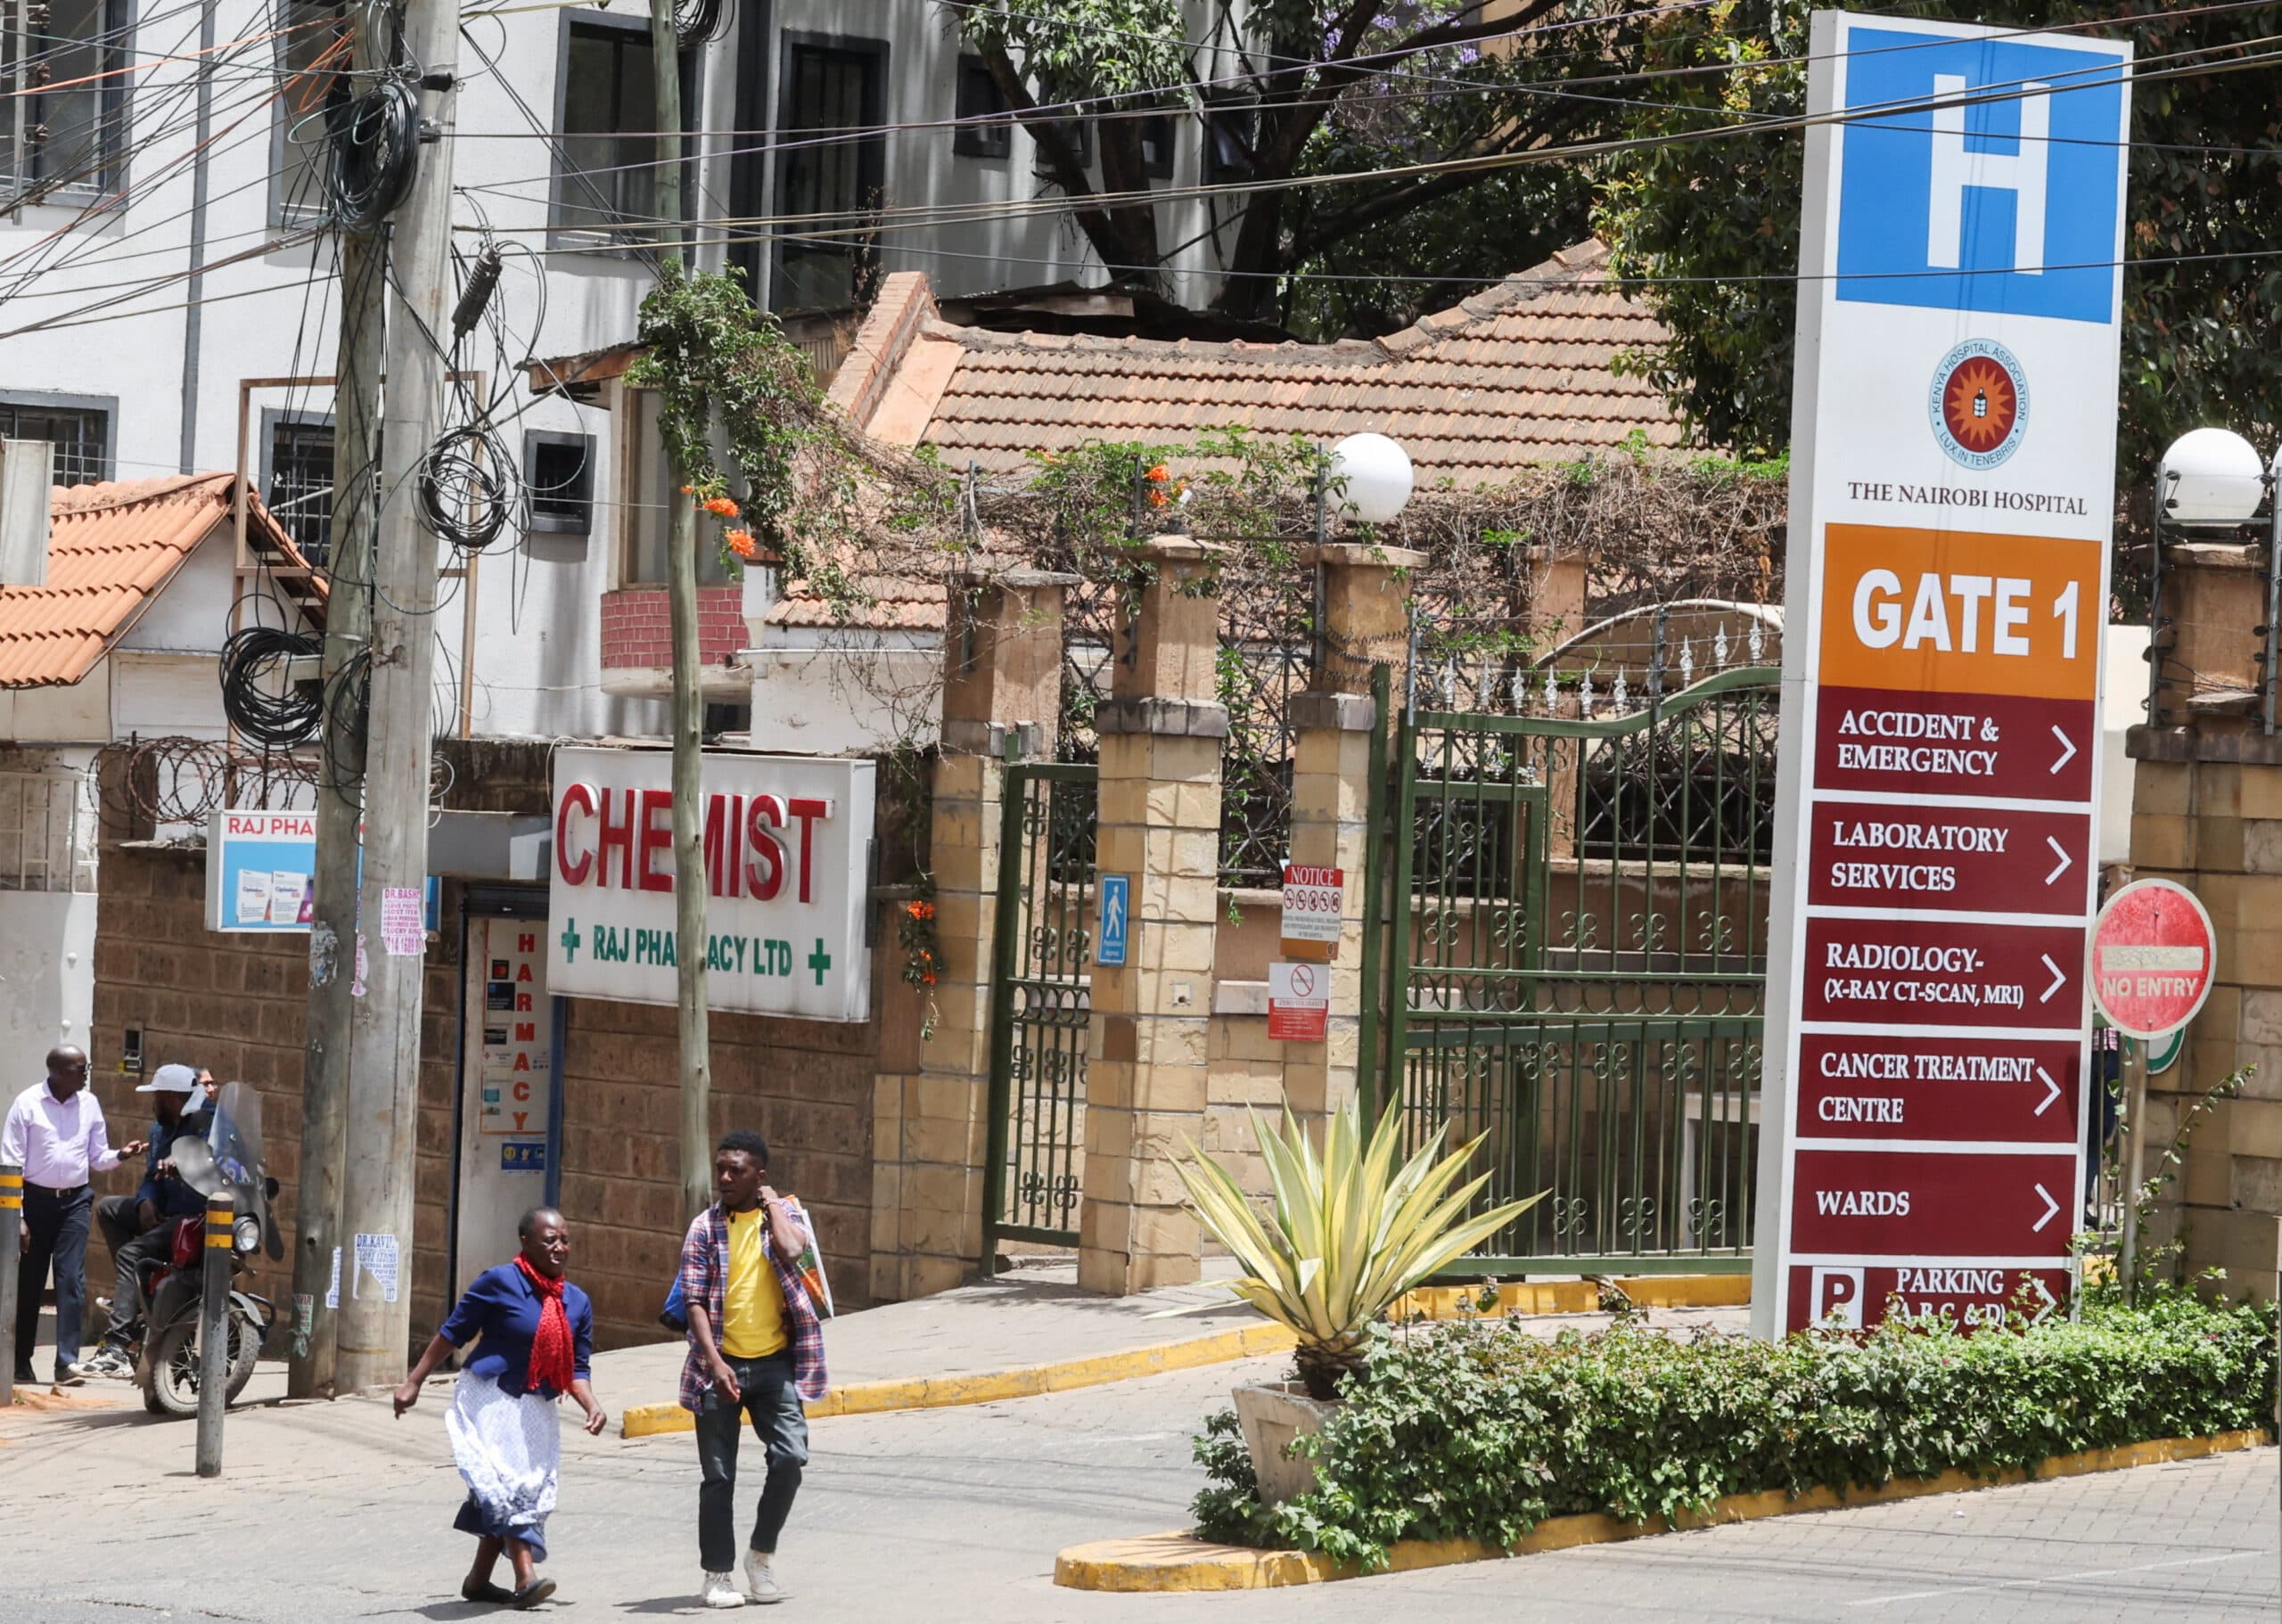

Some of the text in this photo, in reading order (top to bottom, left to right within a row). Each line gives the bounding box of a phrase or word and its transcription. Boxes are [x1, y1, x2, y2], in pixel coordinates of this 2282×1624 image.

[1927, 73, 2050, 275] H
[1933, 343, 2026, 421] KENYA HOSPITAL ASSOCIATION
[1940, 431, 2016, 465] LUX IN TENEBRIS
[1848, 481, 2088, 515] THE NAIROBI HOSPITAL
[1852, 569, 2079, 659] GATE 1
[1838, 709, 1999, 742] ACCIDENT &
[1837, 743, 1998, 775] EMERGENCY
[228, 817, 265, 834] RAJ
[1833, 821, 2009, 852] LABORATORY
[1290, 866, 1334, 886] NOTICE
[1831, 862, 1956, 891] SERVICES
[593, 924, 792, 978] RAJ PHAACY LTD
[1826, 942, 1984, 973] RADIOLOGY-
[1824, 978, 2025, 1010] (X-RAY CT-SCAN, MRI)
[2102, 977, 2198, 997] NO ENTRY
[513, 919, 536, 1131] HARMACY
[1820, 1052, 2035, 1082] CANCER TREATMENT
[1818, 1096, 1904, 1123] CENTRE
[1816, 1191, 1910, 1217] WARDS
[1822, 1268, 2004, 1322] P PARKING
[1964, 1303, 1984, 1325] &
